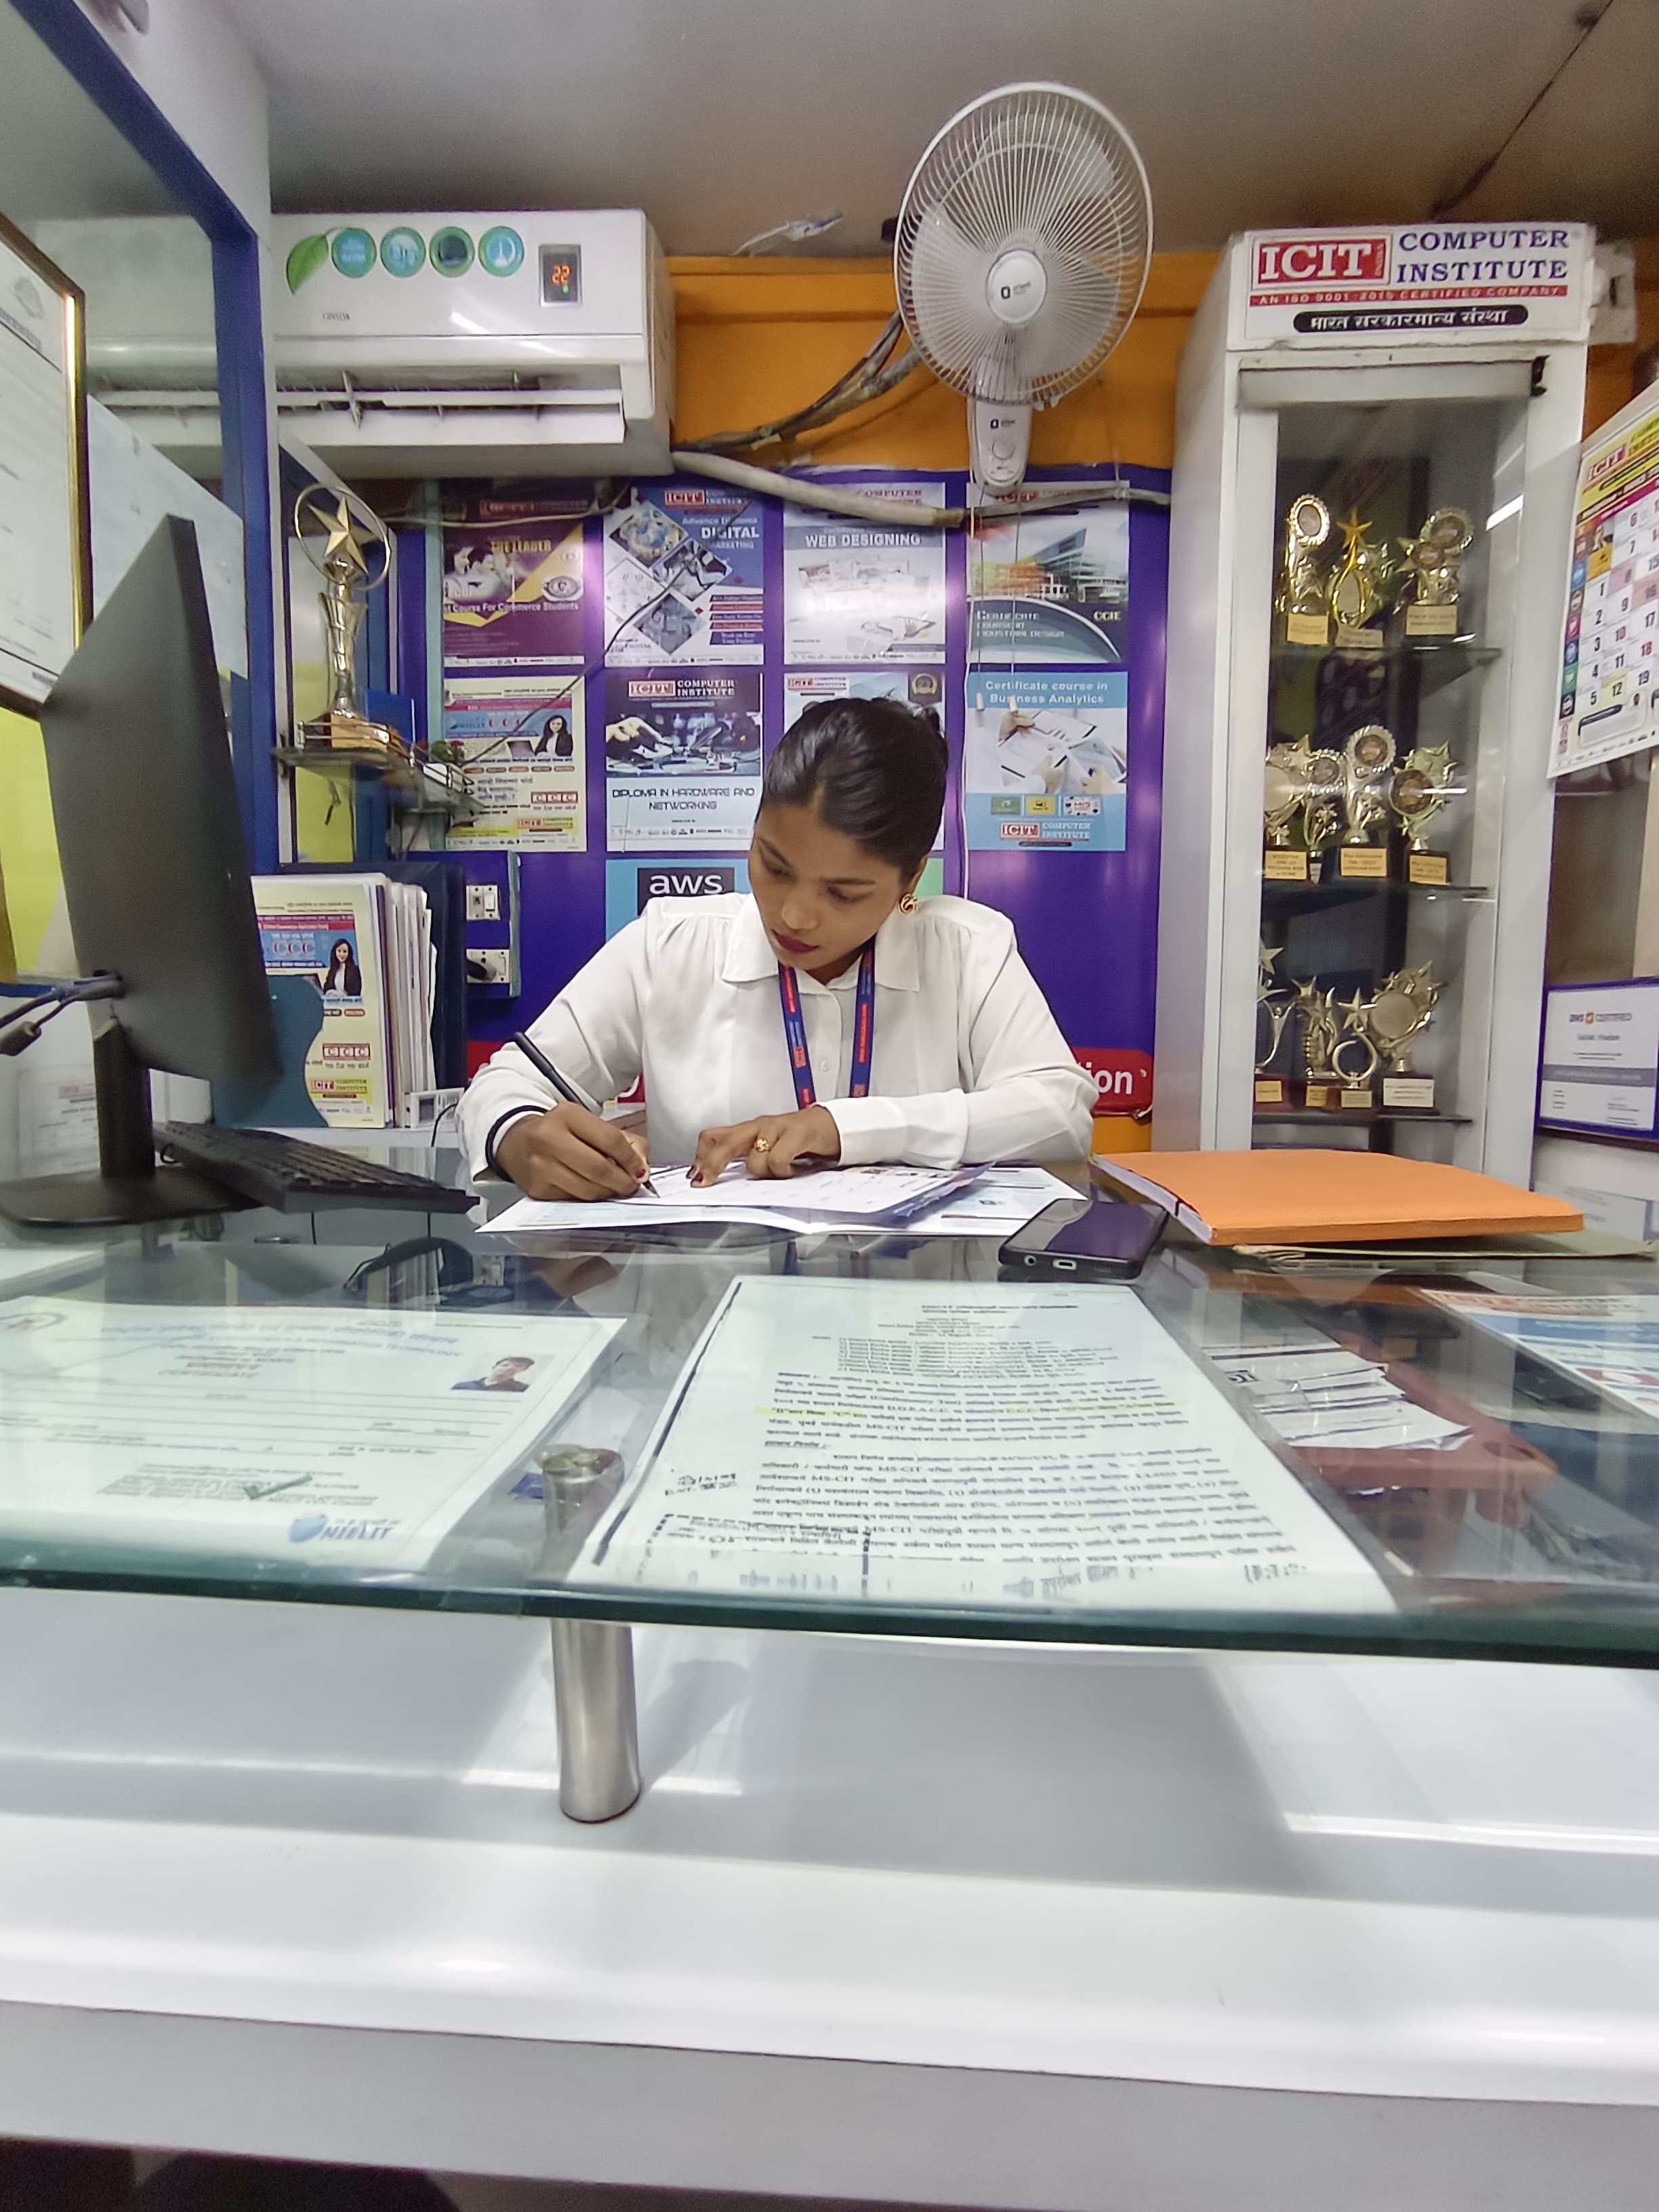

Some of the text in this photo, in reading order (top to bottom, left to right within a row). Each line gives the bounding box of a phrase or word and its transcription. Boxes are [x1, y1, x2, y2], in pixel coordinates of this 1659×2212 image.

[1399, 229, 1570, 251] COMPUTER
[1261, 243, 1372, 280] ICIT
[1396, 260, 1568, 284] INSTITUTE
[1259, 296, 1279, 305] AN
[1285, 295, 1310, 303] ISO
[1399, 288, 1481, 300] CERTIFIED
[1486, 285, 1560, 297] COMPANY
[805, 533, 922, 548] WEB DESIGNING
[1600, 582, 1605, 596] 1
[1622, 597, 1629, 612] 9
[1595, 609, 1603, 626] 2
[1645, 611, 1656, 628] 17
[1615, 626, 1626, 642] 10
[1594, 636, 1601, 652] 3
[1641, 640, 1653, 657] 18
[1615, 653, 1624, 668] 11
[1593, 664, 1599, 678] 4
[1638, 670, 1650, 686] 19
[677, 679, 735, 688] COMPUTER
[1051, 682, 1094, 691] course
[1097, 681, 1108, 691] in
[1612, 681, 1623, 697] 12
[1048, 693, 1105, 705] Analytics
[1590, 691, 1597, 706] 5
[612, 787, 755, 798] DIPLOMA IN HARDWARE AND
[648, 800, 718, 811] NETWORKING
[1002, 824, 1036, 836] ICIT
[649, 874, 724, 895] aws
